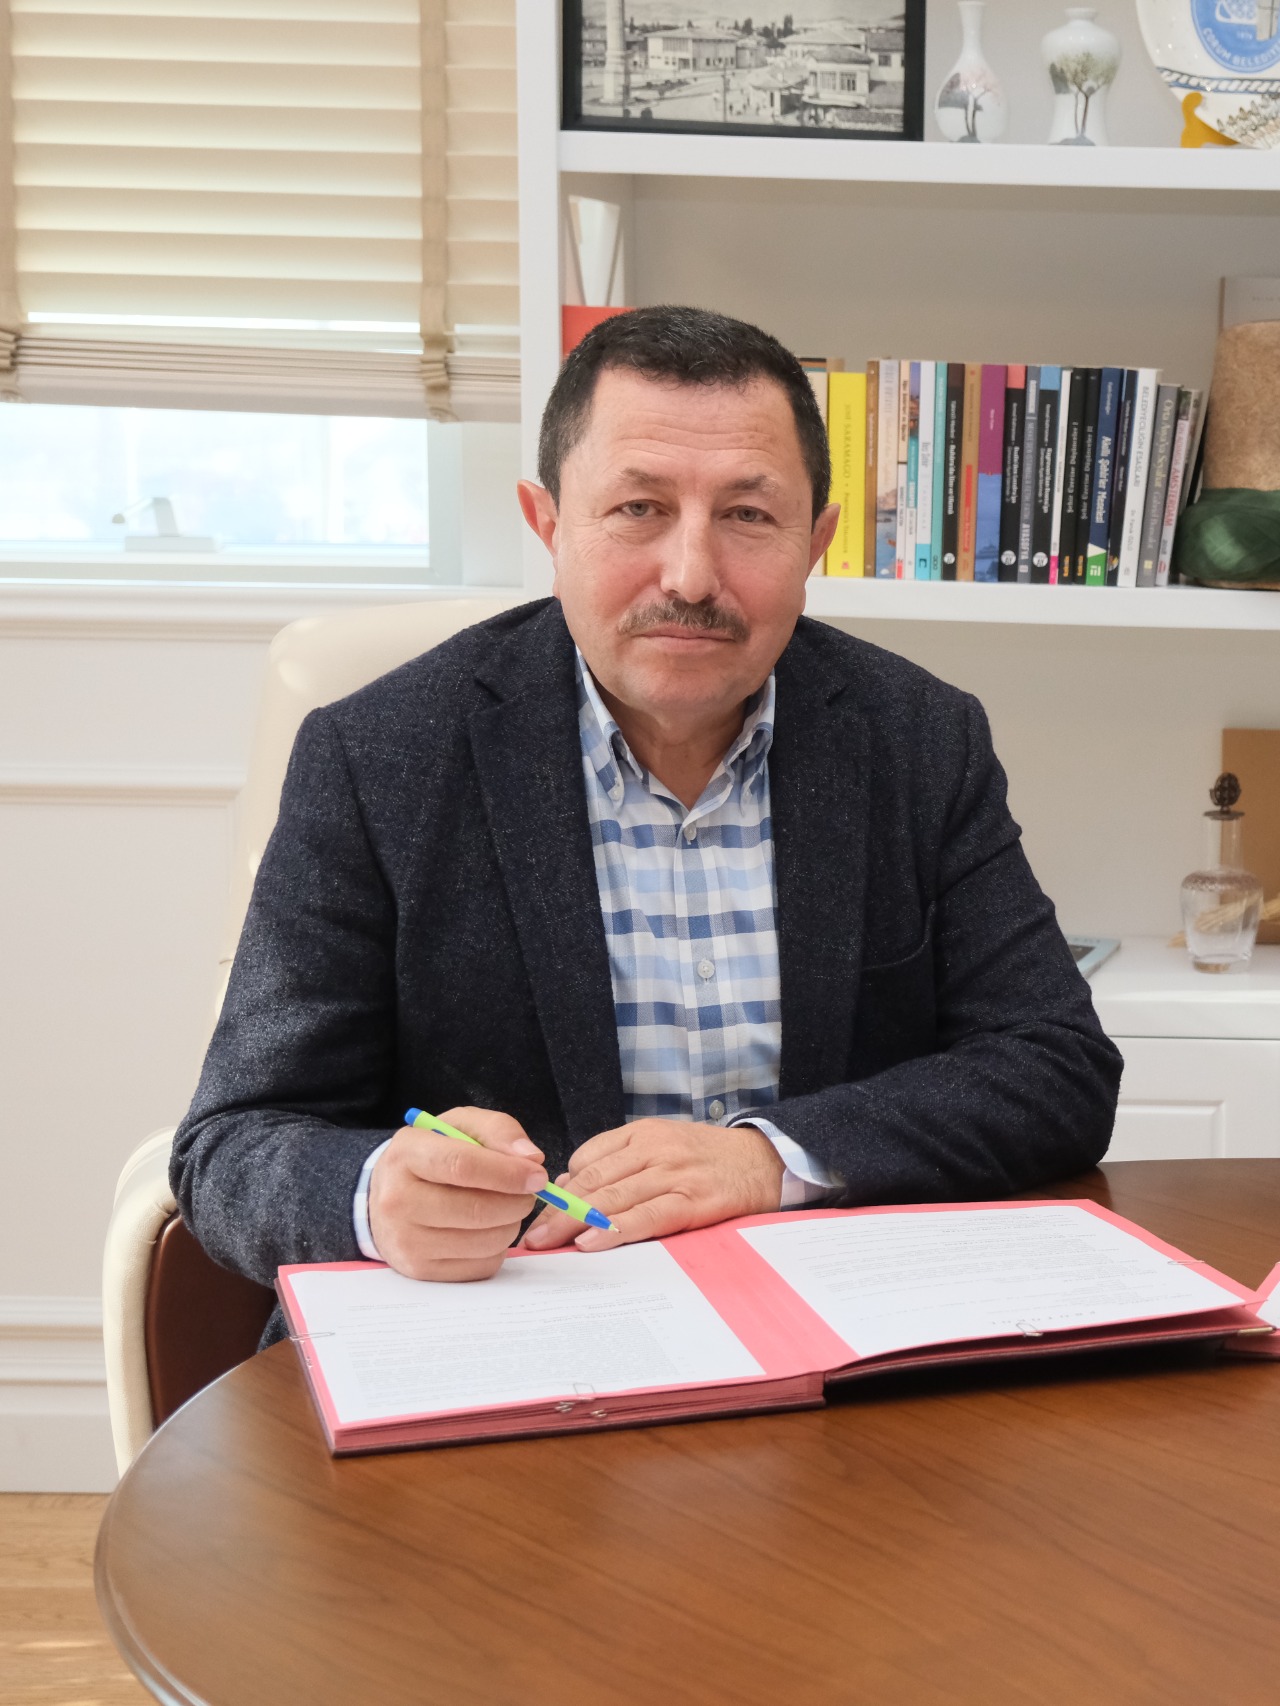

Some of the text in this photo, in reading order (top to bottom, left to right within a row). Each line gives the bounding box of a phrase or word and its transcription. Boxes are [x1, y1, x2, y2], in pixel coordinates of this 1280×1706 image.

[1162, 399, 1175, 421] Orta
[843, 423, 852, 479] SARAMAGO
[1097, 458, 1110, 489] Şehirler
[1133, 450, 1145, 487] ESASLARI
[1153, 455, 1170, 489] Seyahat
[1095, 490, 1108, 524] Meselesi
[1164, 467, 1181, 527] AMSTERDAM
